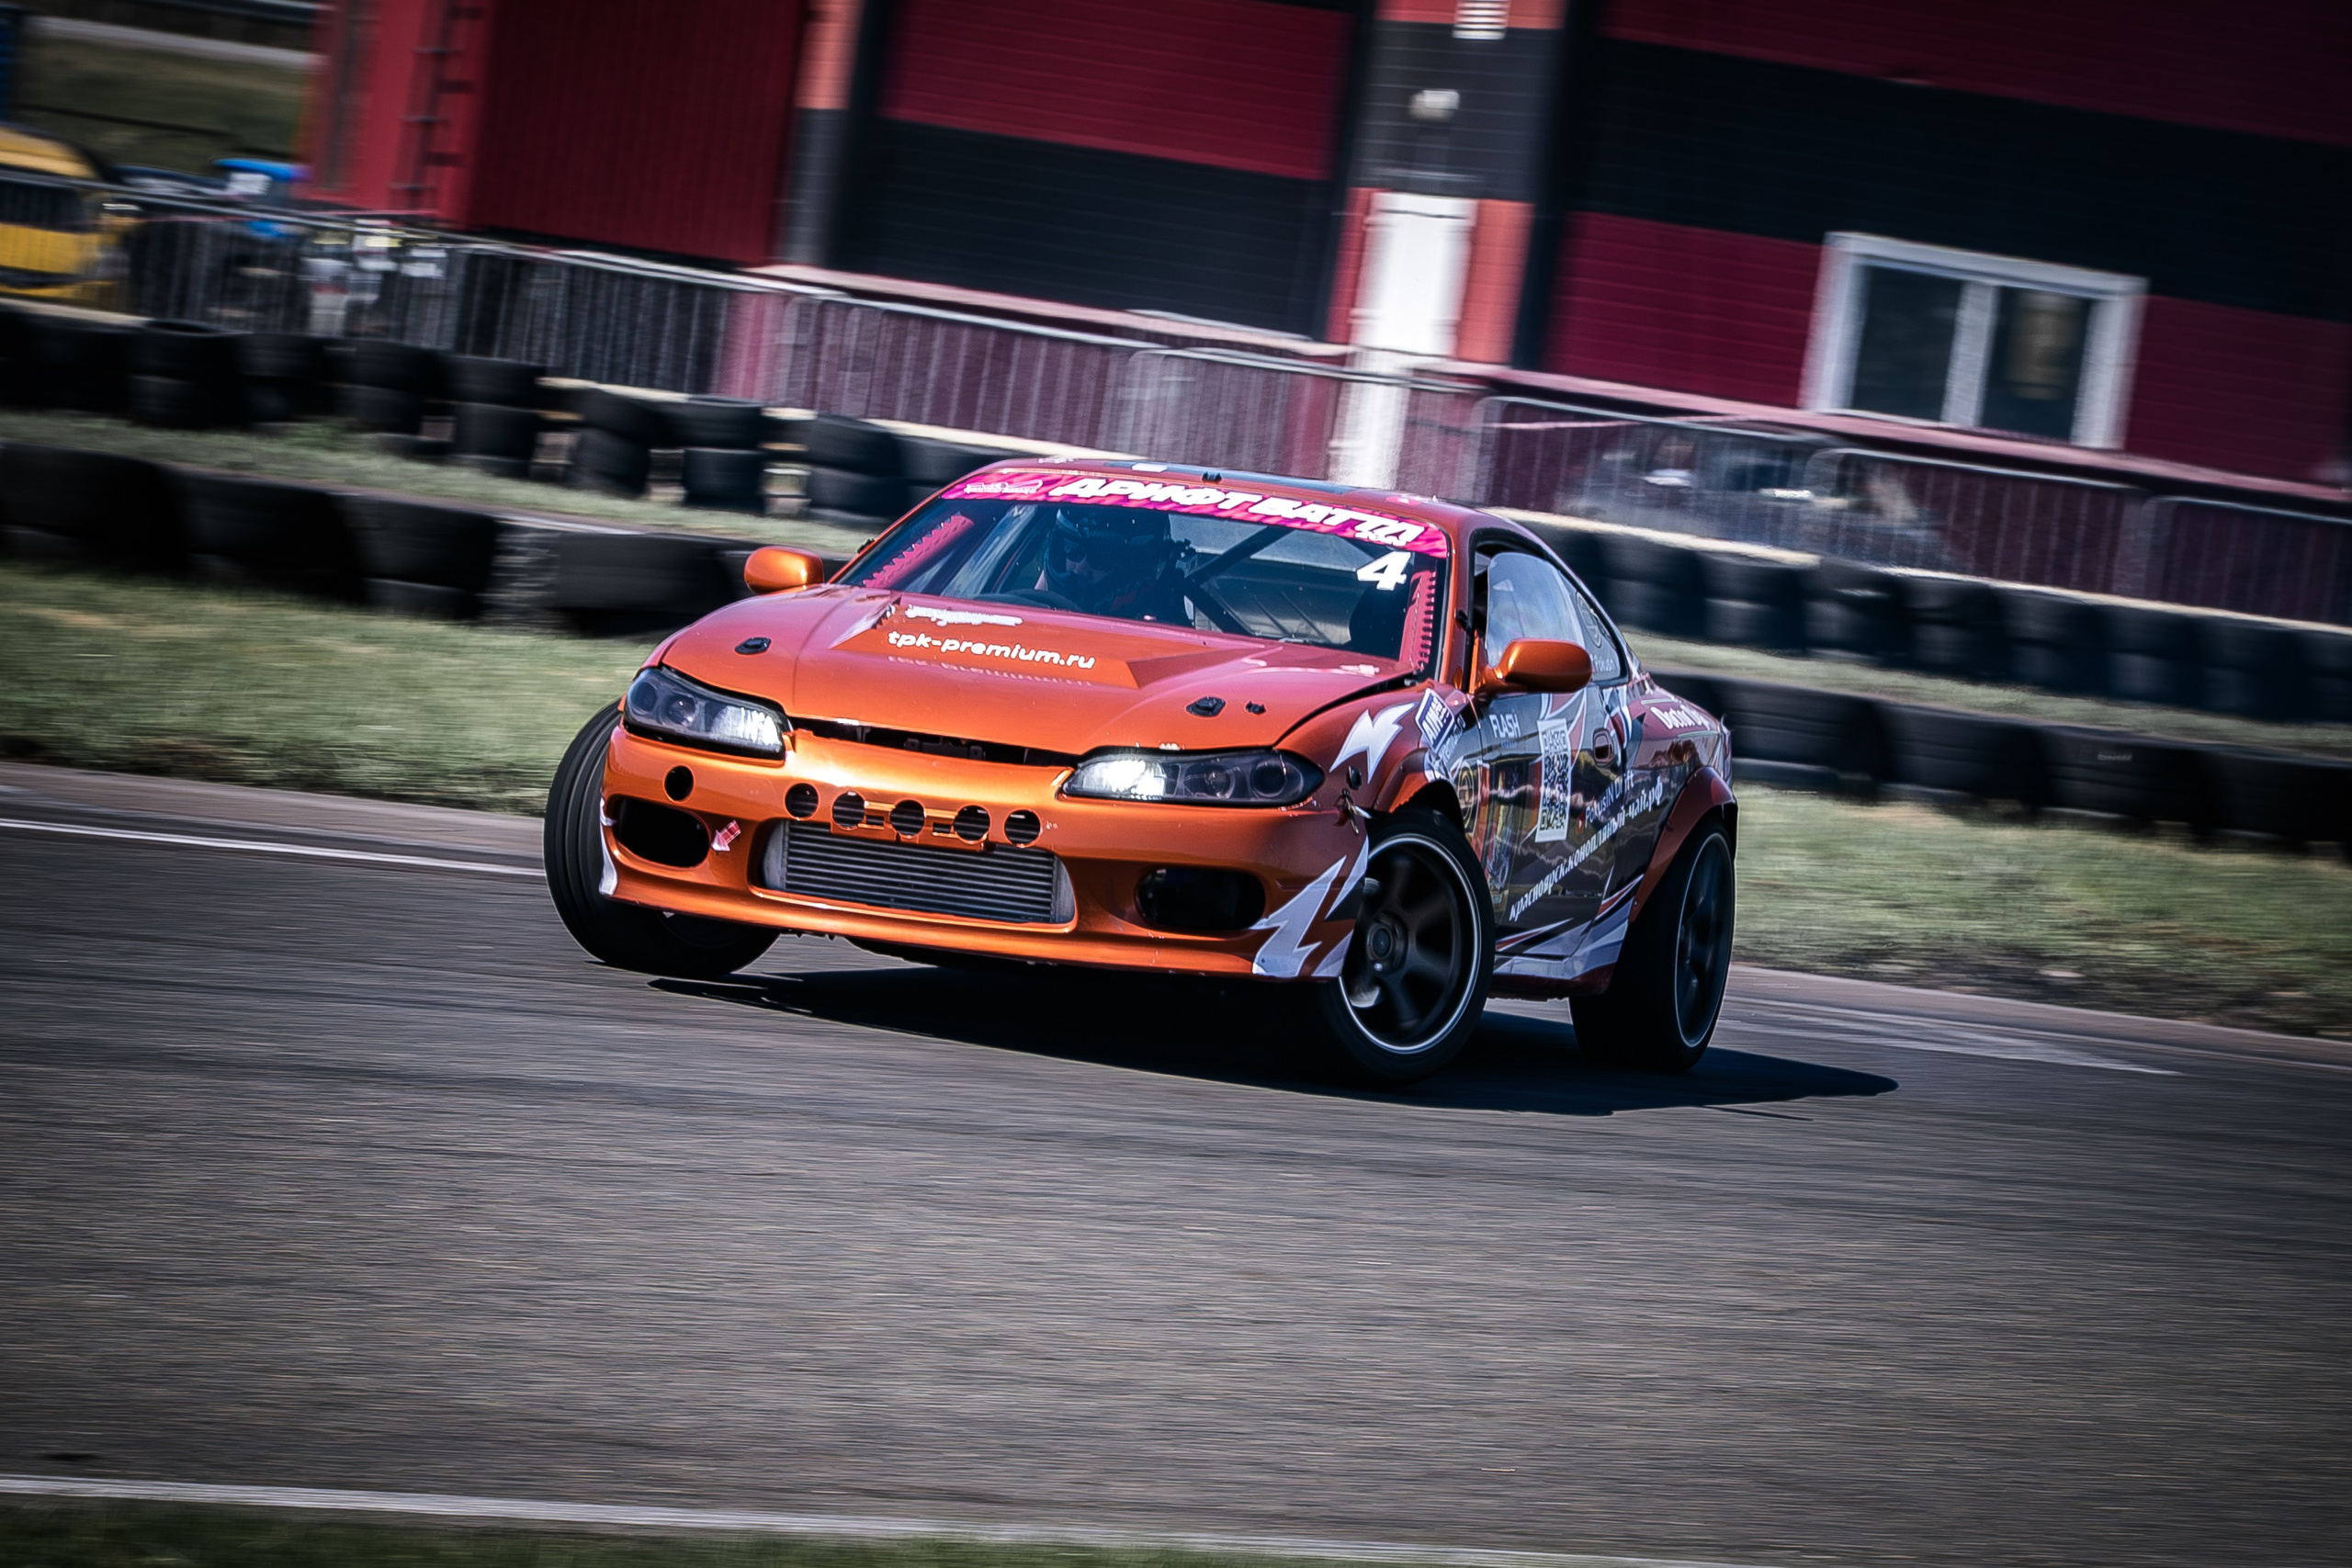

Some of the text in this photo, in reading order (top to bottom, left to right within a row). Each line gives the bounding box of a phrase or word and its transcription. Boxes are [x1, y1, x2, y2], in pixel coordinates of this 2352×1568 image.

[1356, 551, 1408, 592] 4
[888, 630, 1095, 670] tpk-premium.ru
[1488, 713, 1521, 739] FLASH
